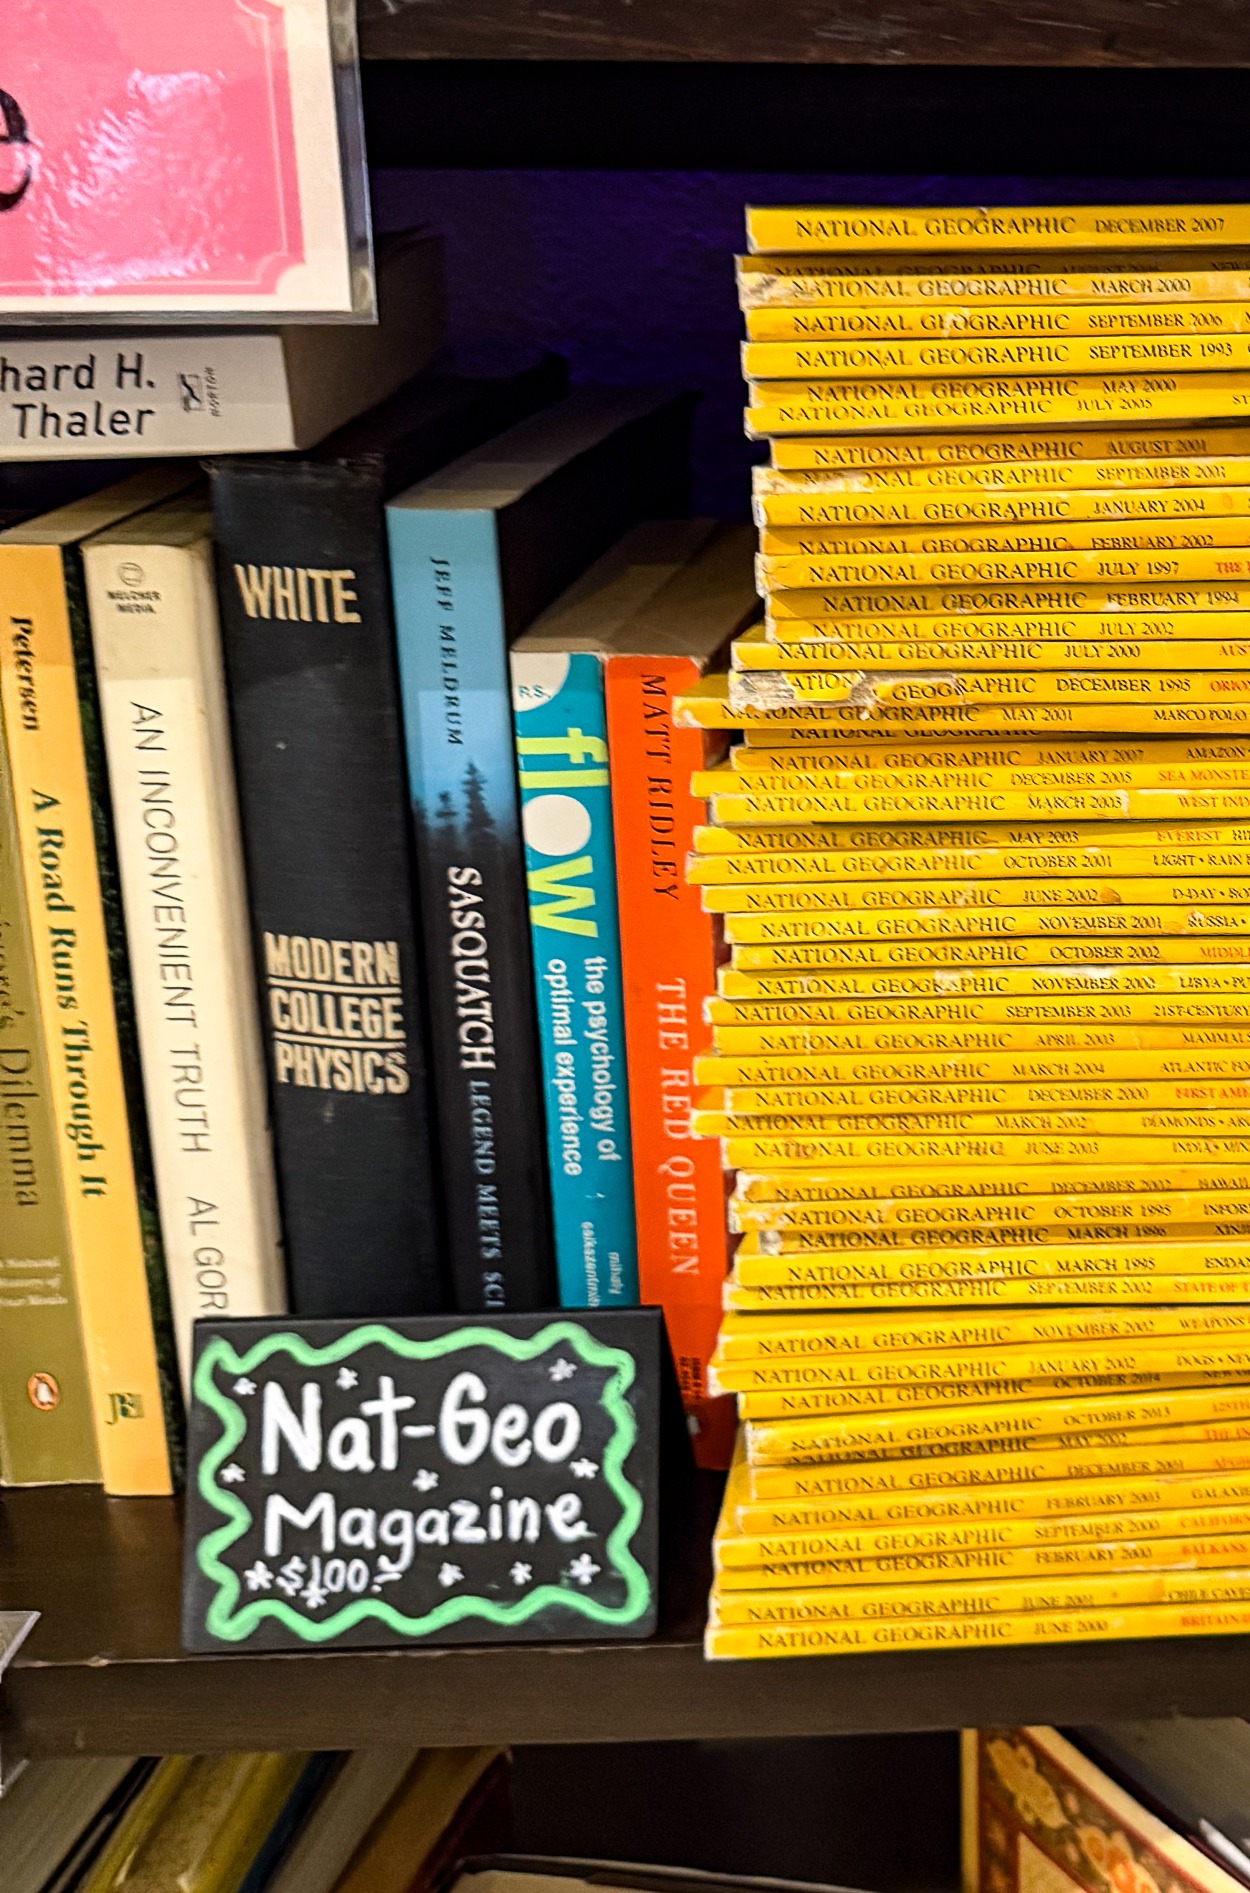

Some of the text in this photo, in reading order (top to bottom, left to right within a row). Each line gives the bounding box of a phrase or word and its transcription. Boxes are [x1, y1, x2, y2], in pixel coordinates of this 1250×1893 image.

[796, 219, 917, 237] NATIONAL
[924, 217, 1076, 237] GEOGRAPHIC
[1095, 218, 1186, 234] DECEMBER
[792, 280, 910, 297] NATIONAL
[917, 279, 1069, 296] GEOGRAPHIC
[1092, 278, 1152, 294] MARCH
[793, 315, 910, 333] NATIONAL
[920, 313, 1069, 331] GEOGRAPHIC
[1088, 312, 1185, 328] SEPTEMBER
[1, 352, 155, 390] hard H.
[795, 350, 911, 368] NATIONAL
[919, 346, 1070, 366] GEOGRAPHIC
[1089, 343, 1192, 359] SEPTEMBER
[1199, 343, 1232, 358] 1993
[11, 401, 155, 438] Thaler
[234, 564, 362, 624] WHITE
[809, 565, 916, 582] NATIONAL
[930, 562, 1078, 580] GEOGRAPHIC
[1097, 561, 1140, 576] JULY
[1215, 560, 1241, 574] THE
[824, 595, 932, 612] NATIONAL
[941, 591, 1087, 610] GEOGRAPHIC
[1106, 591, 1199, 606] FEBRUARY
[10, 616, 39, 731] Petersen
[430, 555, 464, 745] JEFF MELDRUM
[777, 642, 892, 661] NATIONAL
[898, 642, 1043, 660] GEOGRAPHIC
[1064, 643, 1104, 659] JULY
[1056, 677, 1152, 693] DECEMBER
[641, 674, 679, 901] MATT RIDLEY
[516, 727, 611, 939] flow
[726, 857, 837, 874] NATIONAL
[842, 854, 981, 873] GEOGRAPHIC
[1003, 855, 1076, 870] OCTOBER
[130, 701, 212, 1153] AN INCONVENIENT TRUTH
[772, 946, 882, 964] NATIONAL
[889, 944, 1029, 961] GEOGRAPHIC
[1050, 945, 1124, 960] OCTOBER
[263, 931, 400, 983] MODERN
[447, 866, 497, 1071] SASQUATCH
[32, 788, 108, 1199] A Road Runs Through It
[269, 987, 406, 1041] COLLEGE
[274, 1042, 410, 1095] PHYSICS
[543, 958, 584, 1177] optimal experience
[581, 956, 622, 1162] the psychology of
[0, 1049, 39, 1207] Dilemma
[468, 1080, 496, 1175] LEGEND
[655, 977, 700, 1276] THE RED QUEEN
[475, 1184, 502, 1260] MEETS
[782, 1209, 888, 1226] NATIONAL
[896, 1205, 1036, 1224] GEOGRAPHIC
[1054, 1204, 1133, 1219] OCTOBER
[187, 1196, 229, 1319] AL GOR
[788, 1265, 890, 1282] NATIONAL
[900, 1260, 1039, 1278] GEOGRAPHIC
[1057, 1258, 1119, 1274] MARCH
[261, 1371, 582, 1476] Nat-Geo
[263, 1486, 590, 1572] Magazine
[758, 1630, 867, 1649] NATIONAL
[873, 1623, 1013, 1644] GEOGRAPHIC
[1034, 1620, 1073, 1636] JUNE
